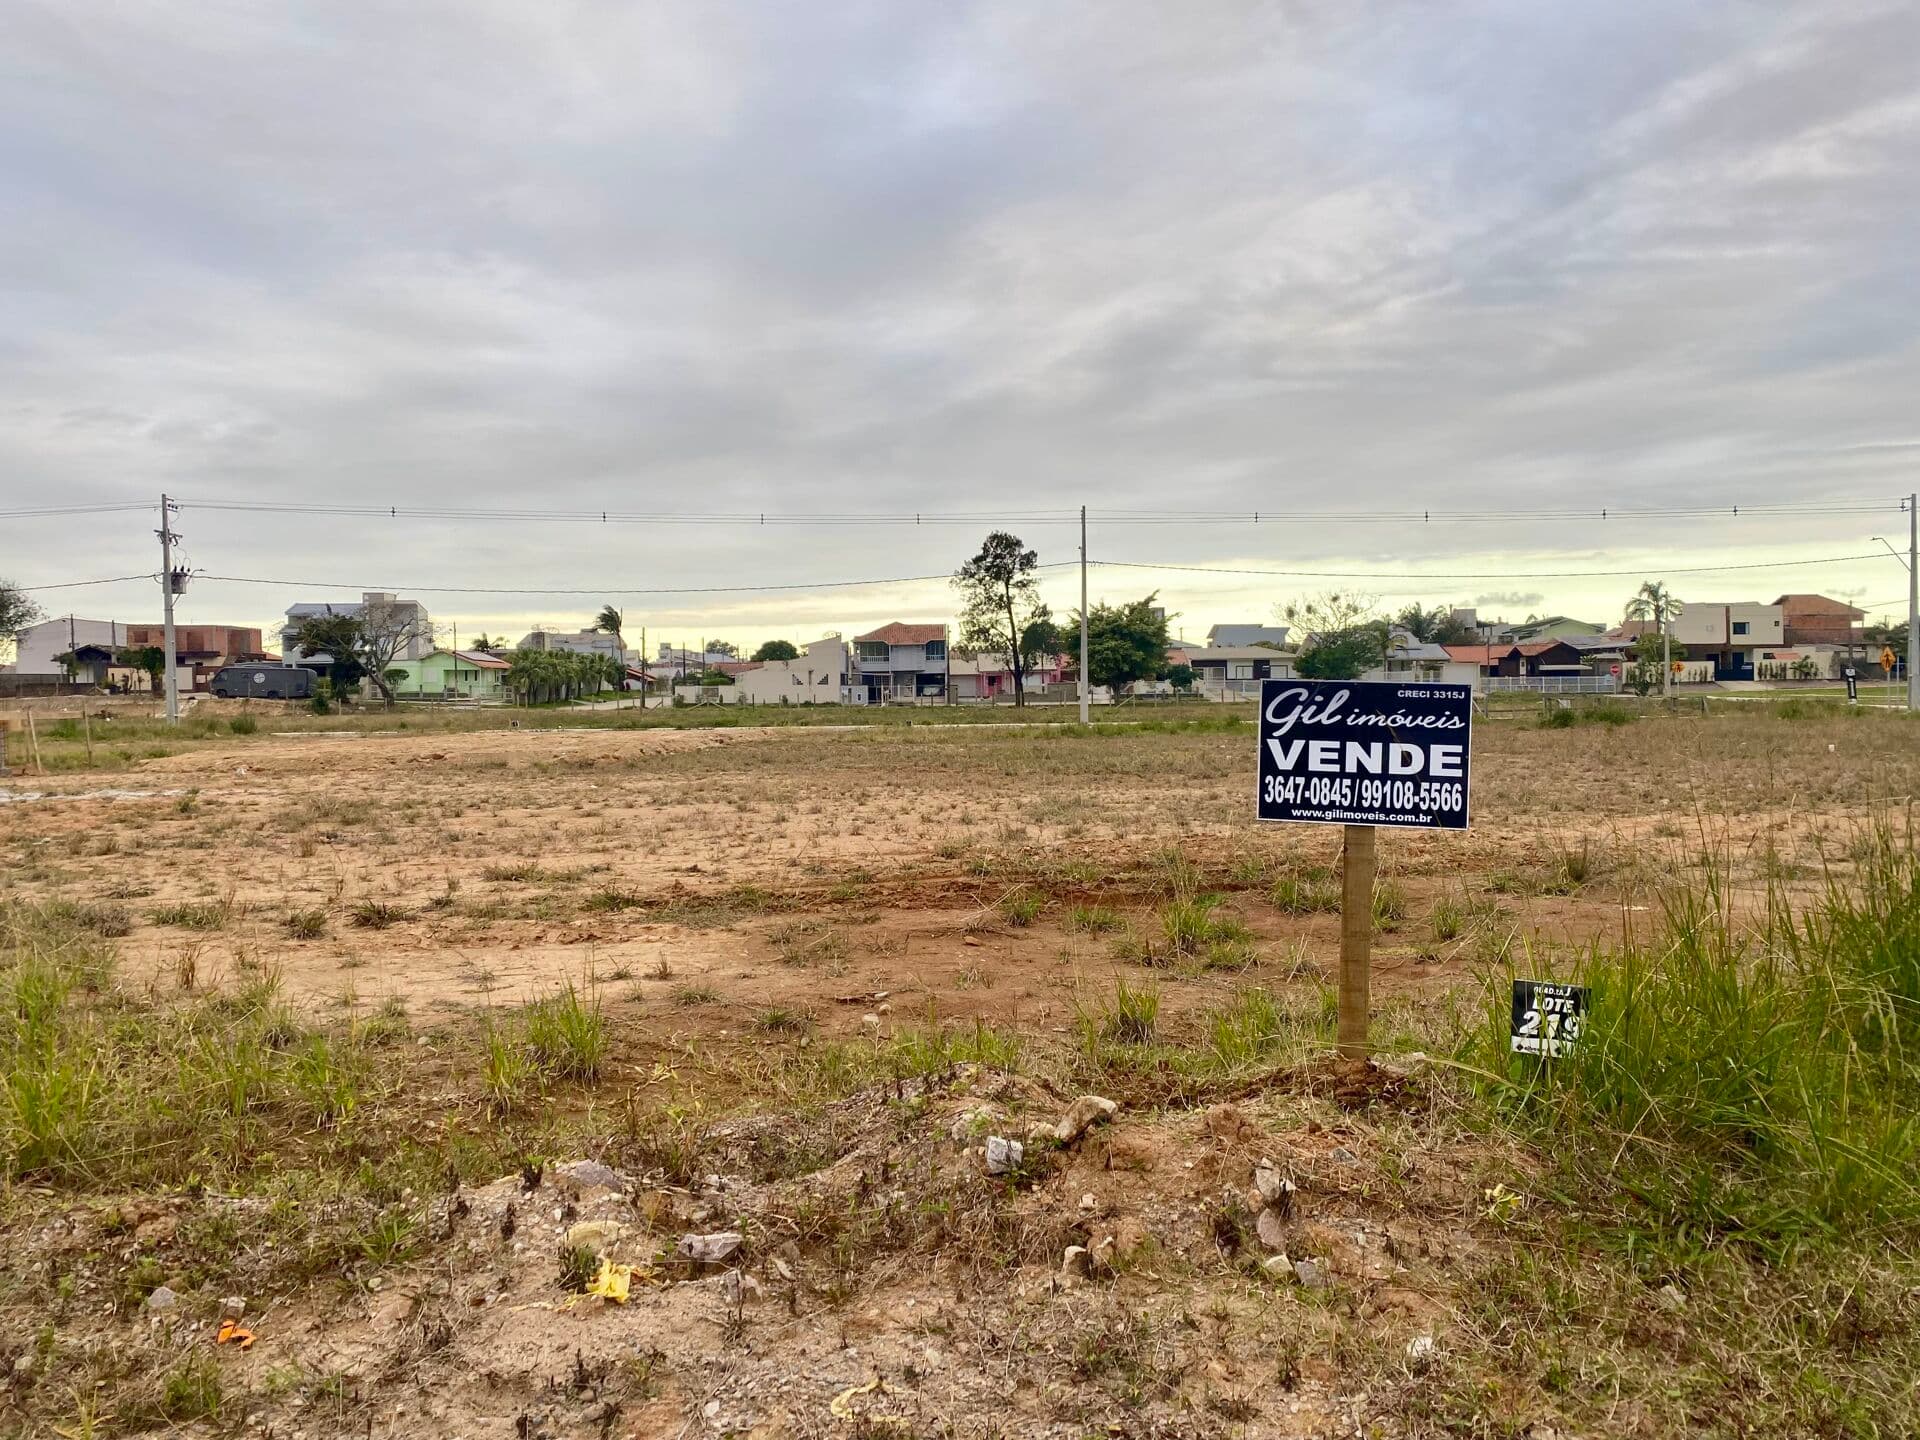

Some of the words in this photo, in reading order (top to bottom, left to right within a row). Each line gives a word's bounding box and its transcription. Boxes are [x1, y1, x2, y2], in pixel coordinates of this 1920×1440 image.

[1397, 690, 1430, 698] CRECI
[1433, 691, 1465, 699] 3315J
[1265, 688, 1350, 737] Gil
[1346, 708, 1466, 729] imóveis
[1266, 738, 1463, 777] VENDE
[1291, 808, 1433, 823] www.gilimoveis.com.br
